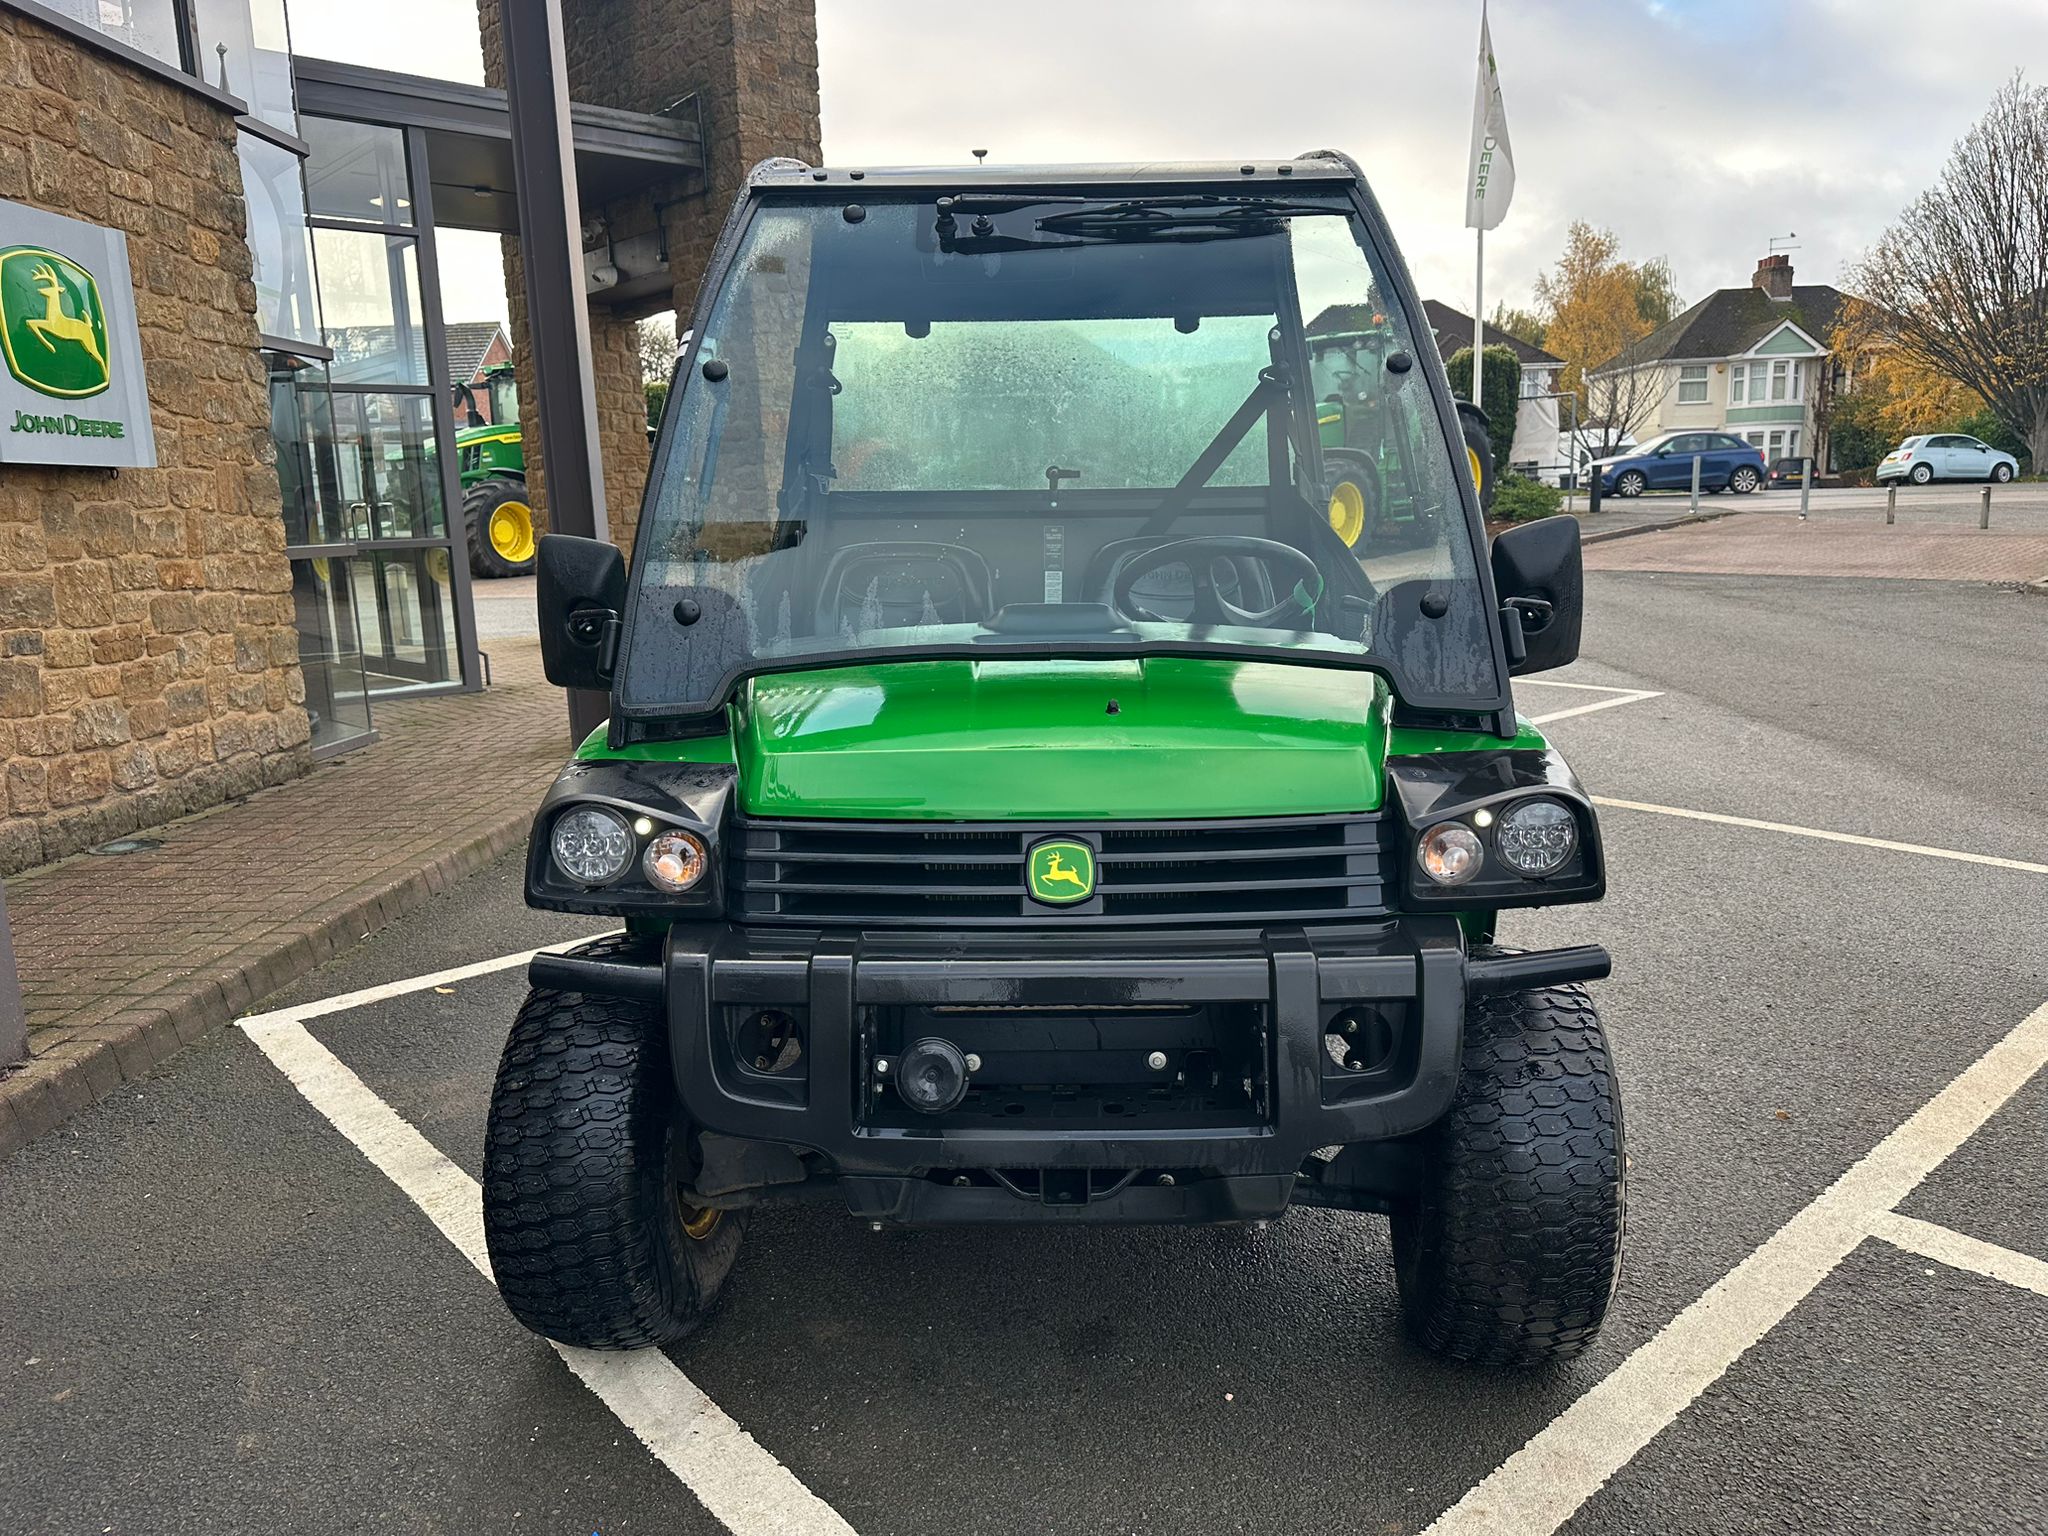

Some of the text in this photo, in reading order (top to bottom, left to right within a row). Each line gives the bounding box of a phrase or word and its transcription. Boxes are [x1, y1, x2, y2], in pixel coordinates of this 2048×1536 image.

[1474, 136, 1497, 200] DEERE
[10, 410, 125, 438] JOHN DEERE
